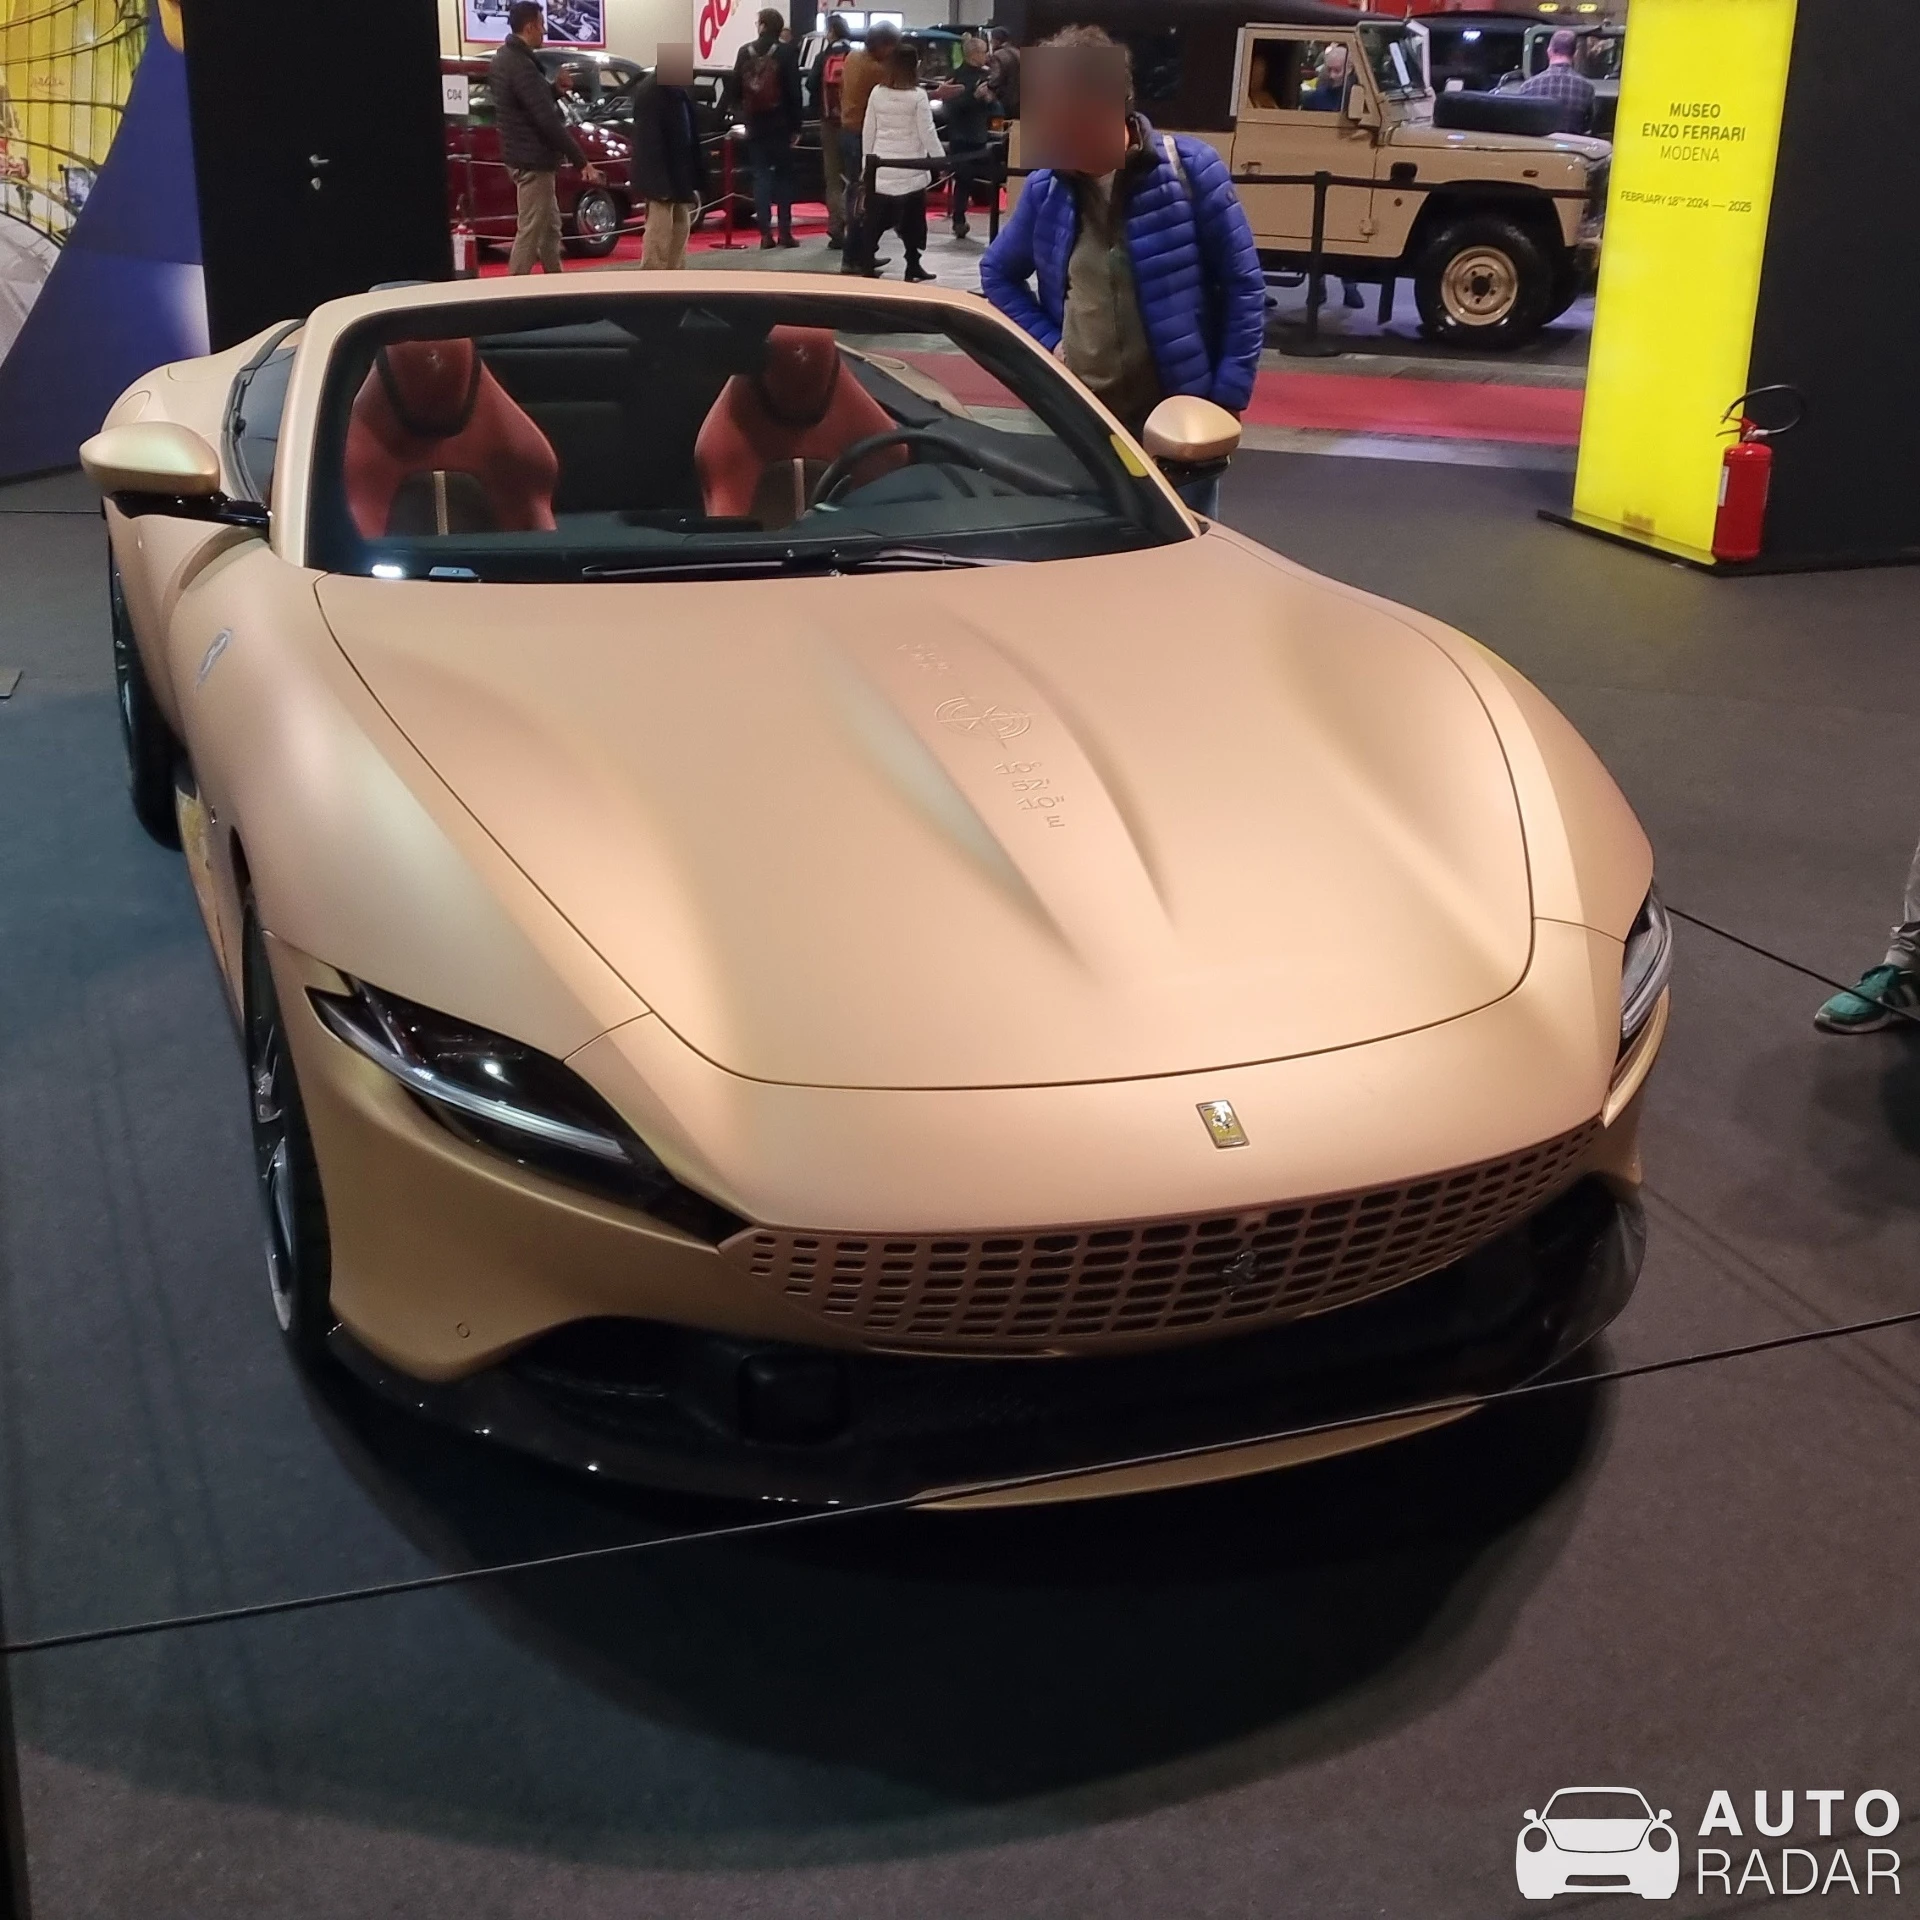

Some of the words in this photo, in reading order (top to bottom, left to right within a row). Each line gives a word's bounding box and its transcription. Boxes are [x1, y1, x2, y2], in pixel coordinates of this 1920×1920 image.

[447, 88, 463, 101] C04
[1669, 102, 1721, 119] MUSEO
[1642, 122, 1679, 139] ENZO
[1682, 125, 1747, 142] FERRARI
[1660, 145, 1720, 162] MODENA
[1620, 190, 1665, 206] FEBRUARY
[1686, 197, 1709, 209] 2024
[1728, 200, 1752, 213] 2025
